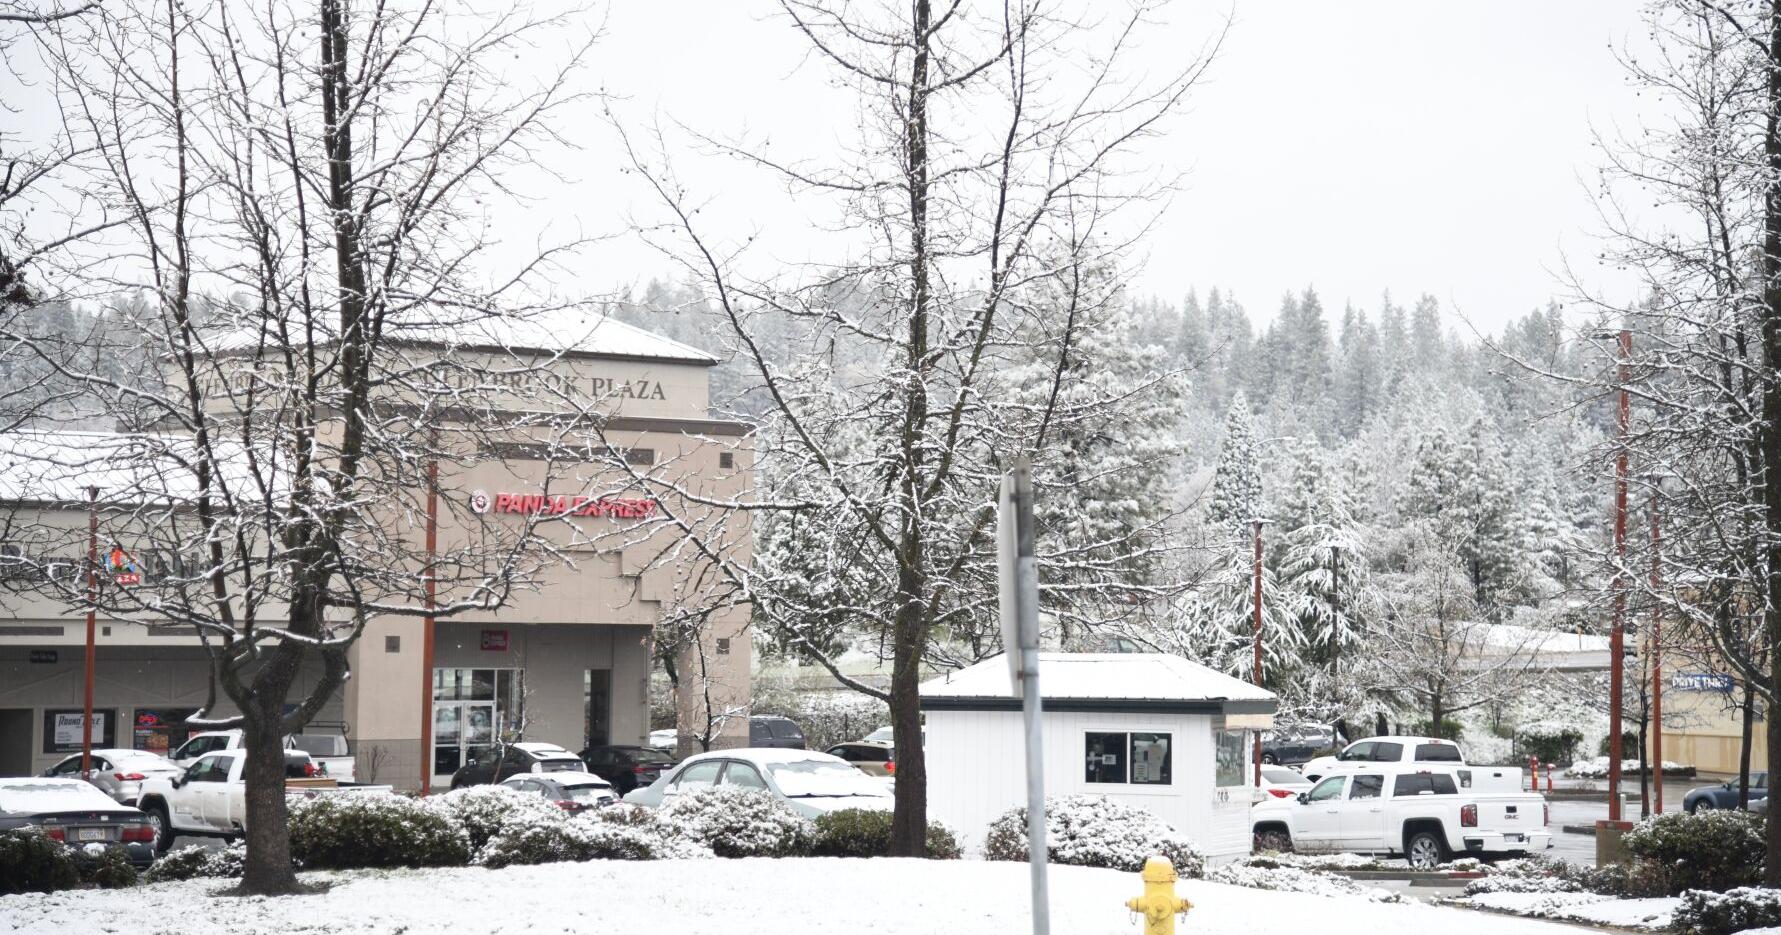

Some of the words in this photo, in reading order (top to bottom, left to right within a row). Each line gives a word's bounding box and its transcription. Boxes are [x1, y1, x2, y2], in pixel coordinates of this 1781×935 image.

[592, 377, 666, 400] PLAZA
[496, 492, 567, 515] PANDA
[572, 496, 657, 519] EXPRESS
